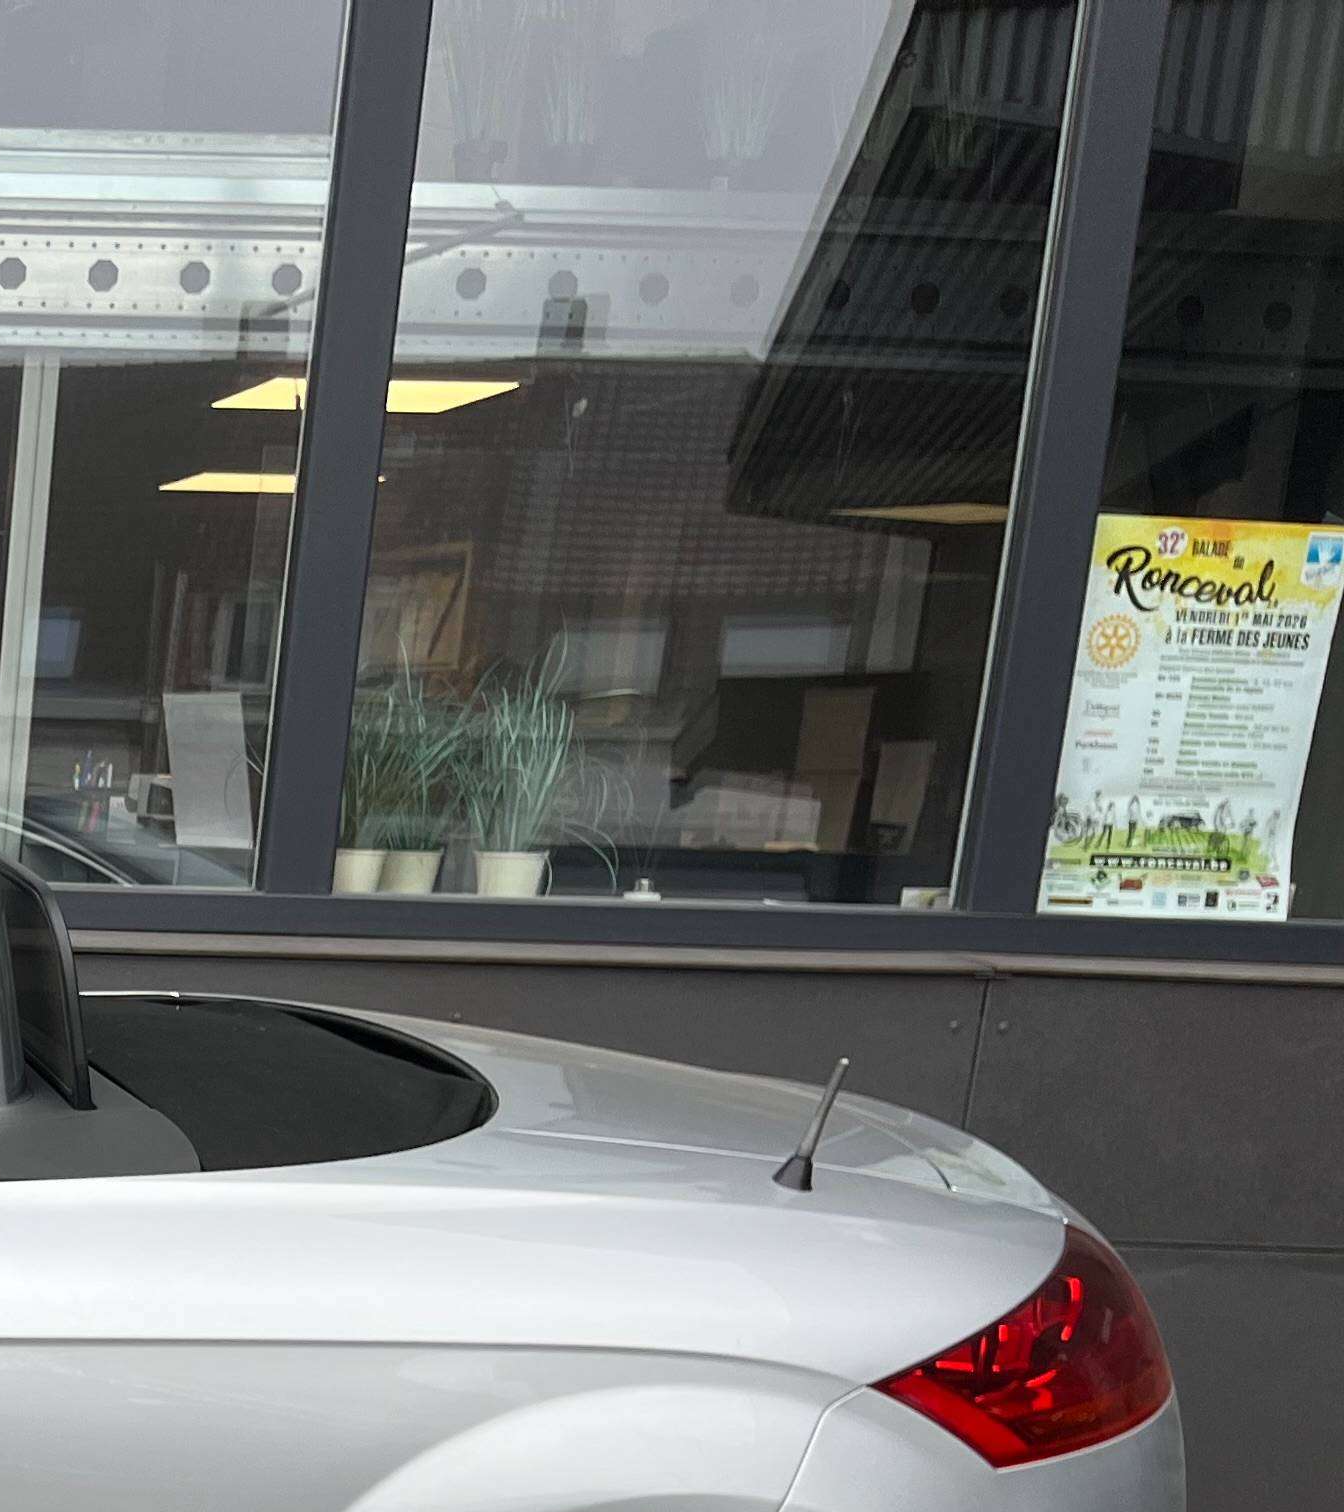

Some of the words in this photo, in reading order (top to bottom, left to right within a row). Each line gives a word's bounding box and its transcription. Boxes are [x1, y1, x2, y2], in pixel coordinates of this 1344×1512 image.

[1106, 545, 1277, 612] Ronceval
[1175, 609, 1231, 625] VENDREDI
[1252, 611, 1274, 627] MAI
[1176, 628, 1188, 645] la
[1190, 628, 1234, 646] FERME
[1236, 631, 1260, 648] DES
[1261, 632, 1311, 651] JEUNES
